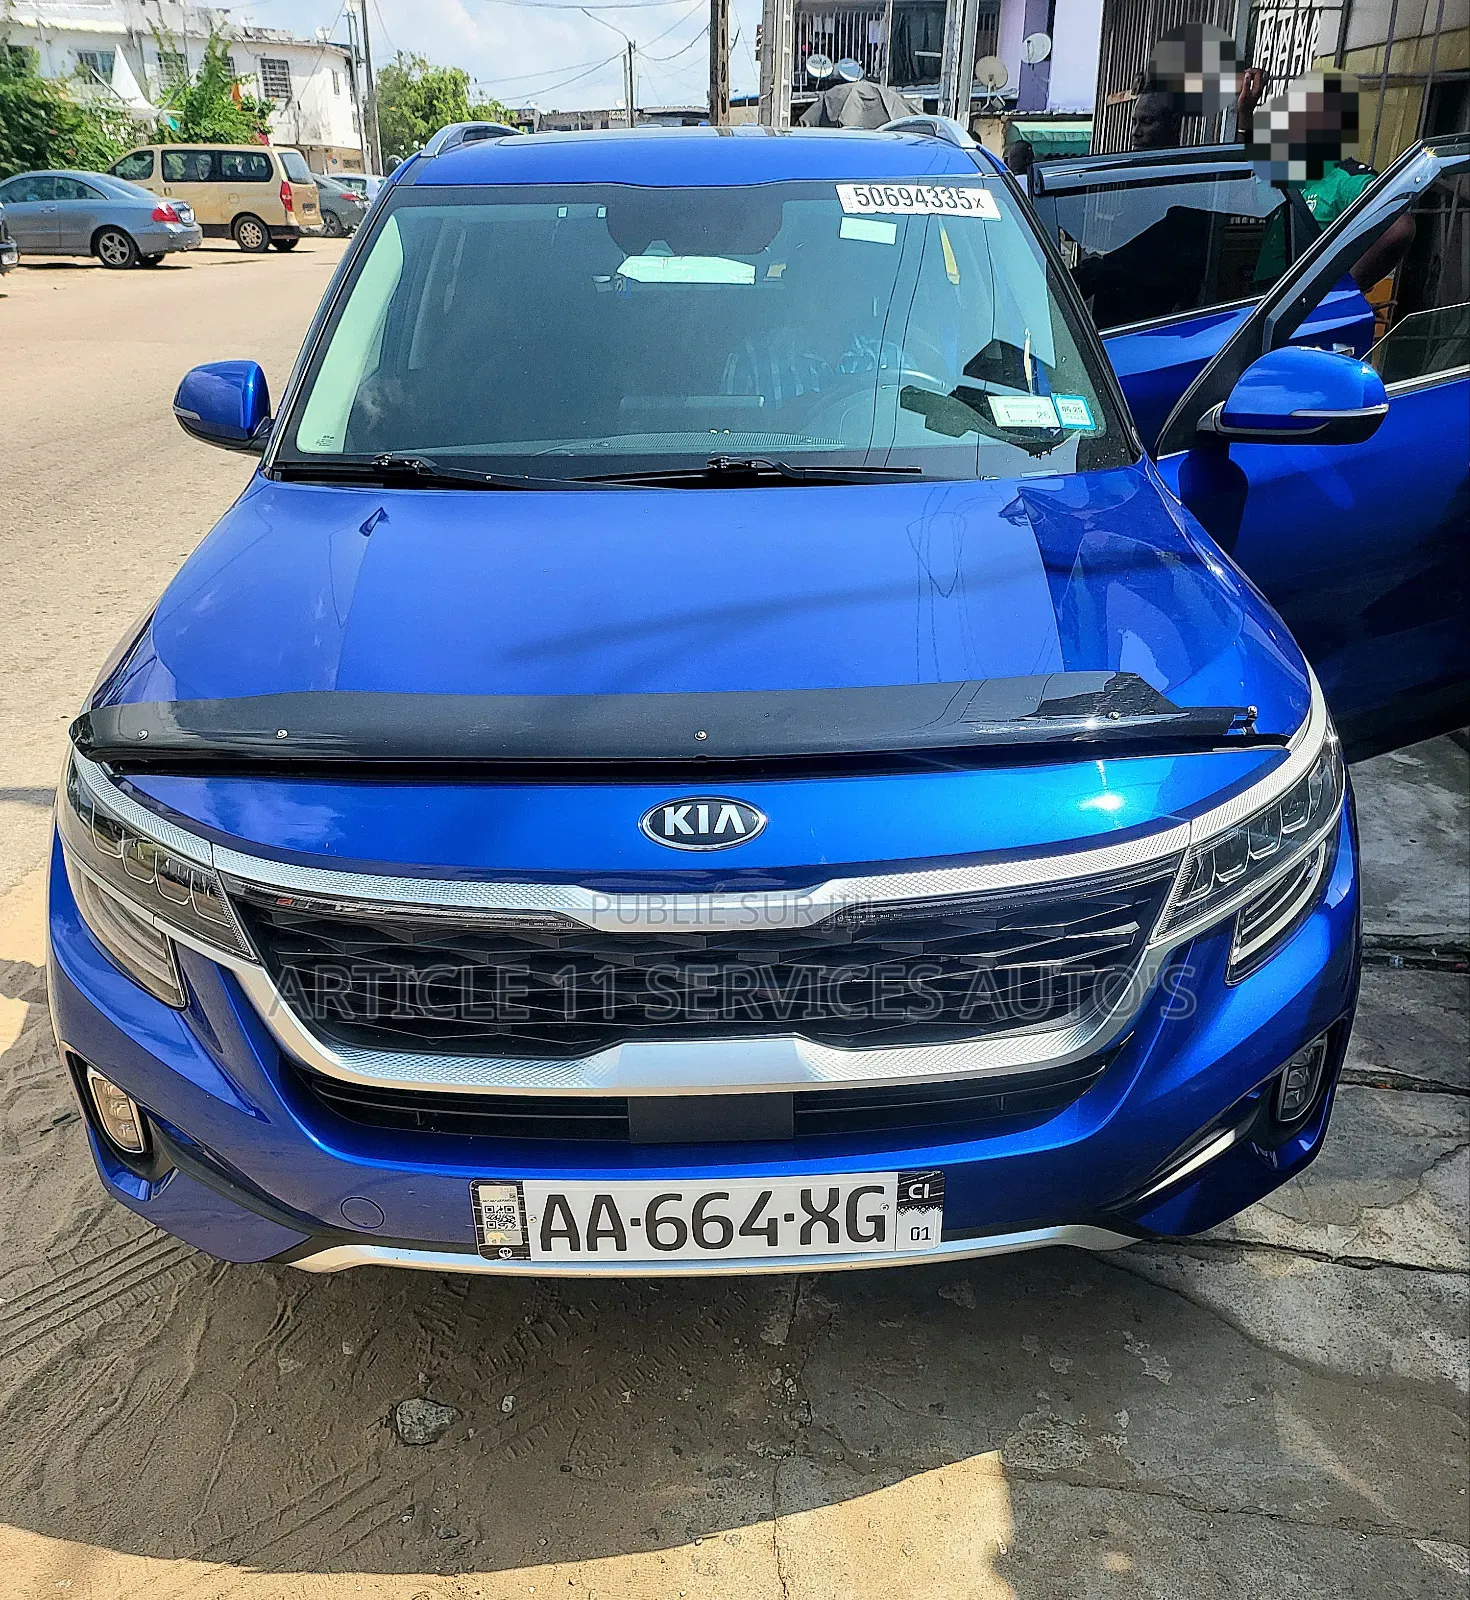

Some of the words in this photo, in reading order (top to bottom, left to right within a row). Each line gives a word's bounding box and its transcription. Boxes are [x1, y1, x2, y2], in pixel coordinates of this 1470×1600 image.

[663, 804, 746, 836] KIA
[907, 1183, 931, 1200] CI
[909, 1225, 933, 1242] 01
